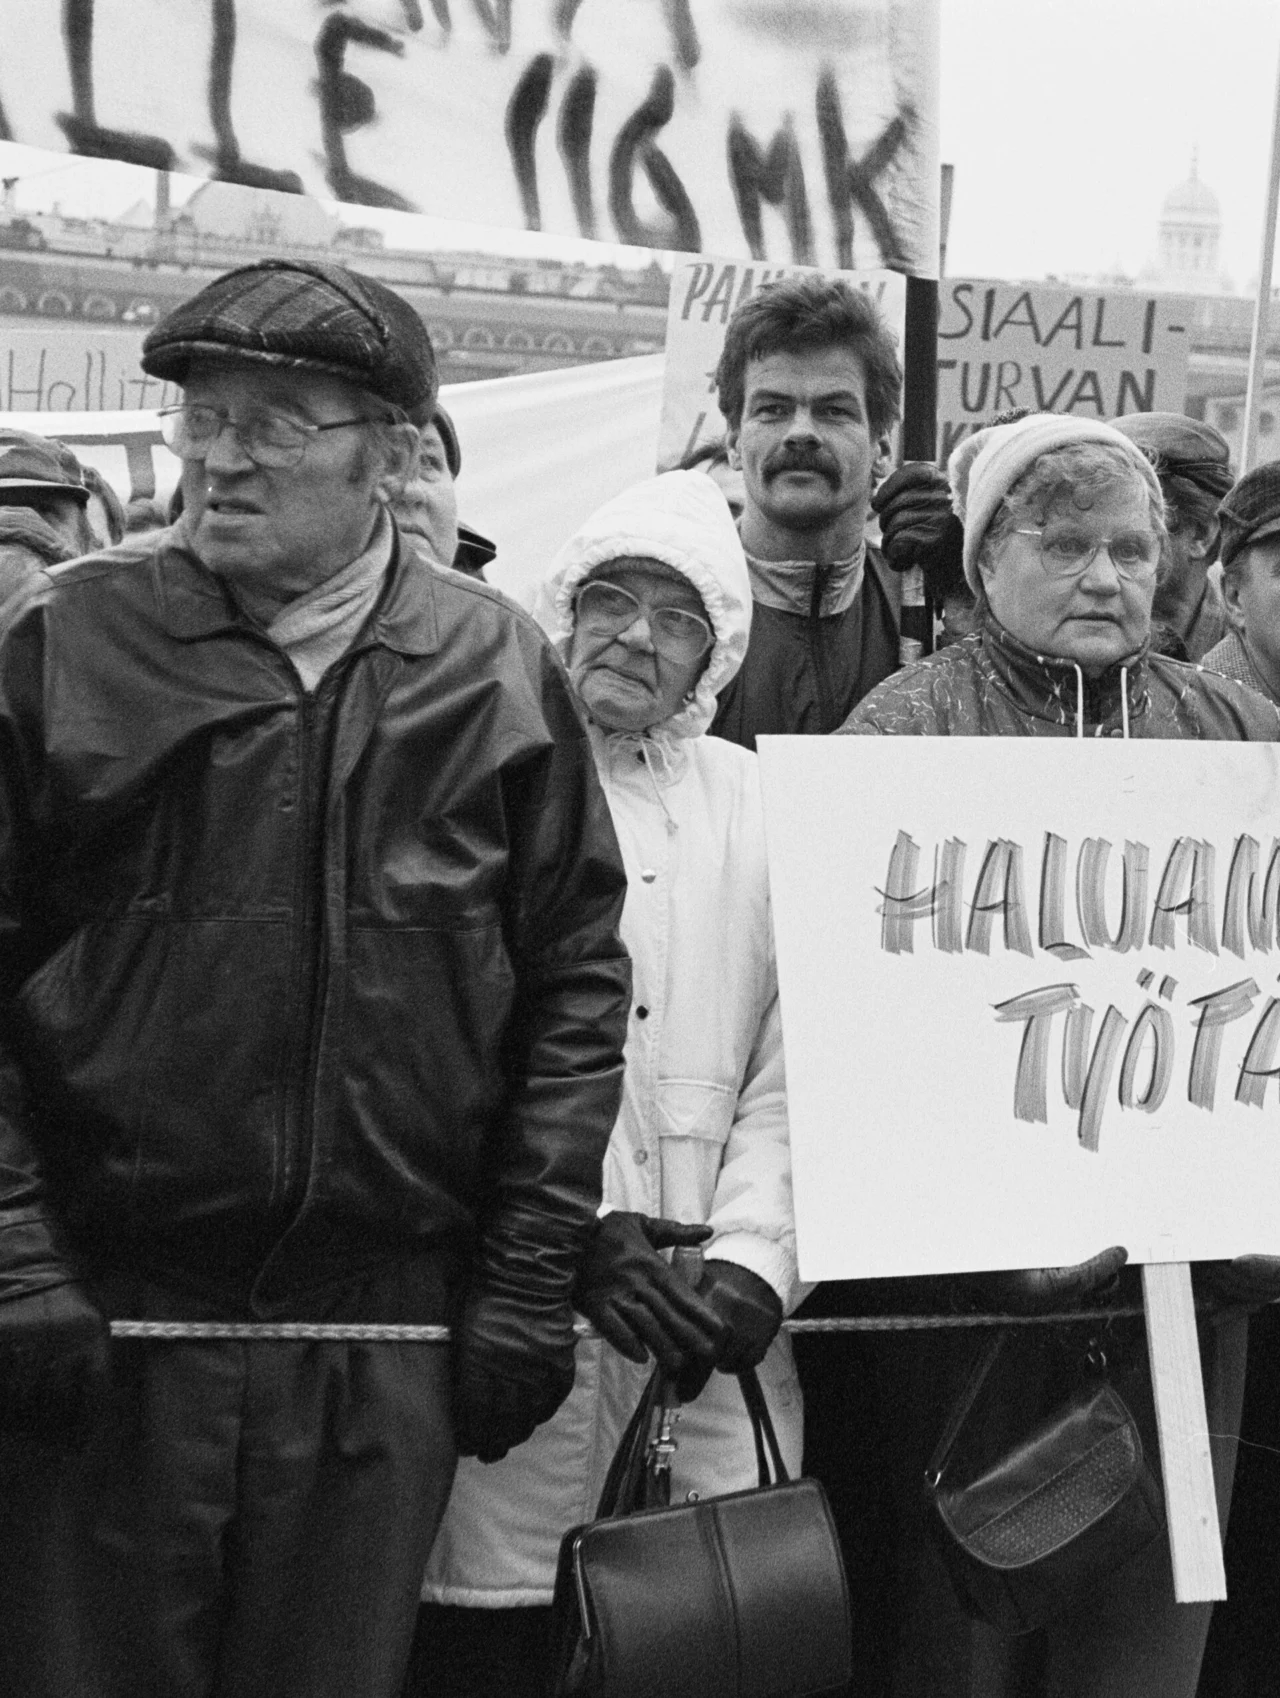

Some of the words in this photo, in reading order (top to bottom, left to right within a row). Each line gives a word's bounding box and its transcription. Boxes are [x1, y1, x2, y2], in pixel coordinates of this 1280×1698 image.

[0, 0, 415, 213] LLE
[726, 62, 912, 271] MK
[937, 282, 1186, 354] SIAALI-
[8, 348, 183, 412] Hallit
